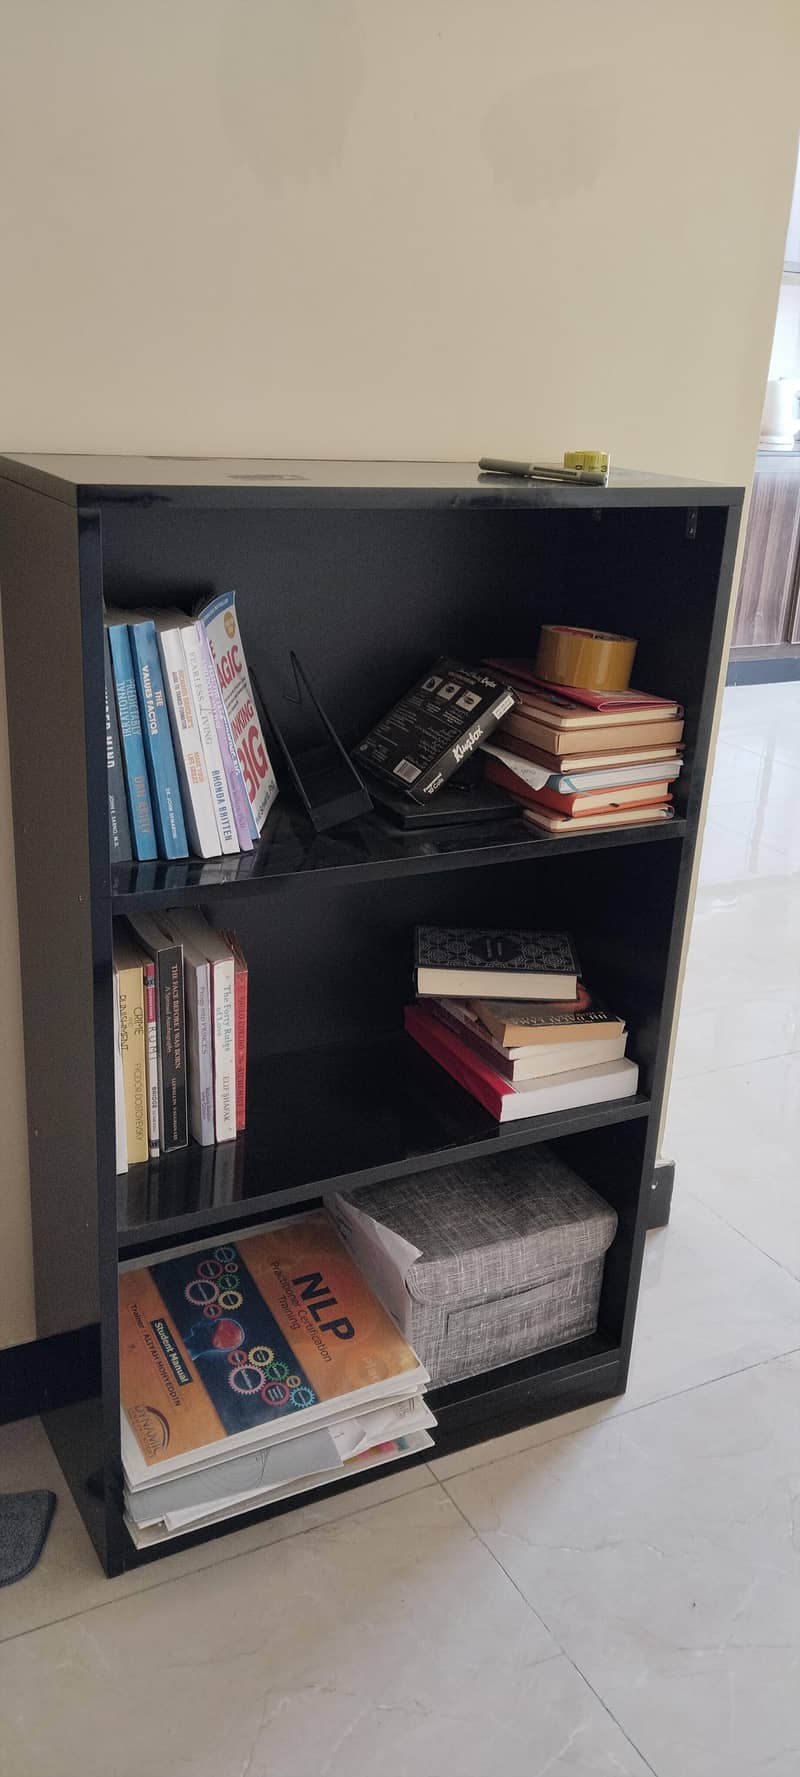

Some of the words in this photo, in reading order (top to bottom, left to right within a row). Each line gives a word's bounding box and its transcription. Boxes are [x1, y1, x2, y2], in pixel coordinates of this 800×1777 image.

[189, 651, 204, 701] FEARLESS
[218, 645, 243, 692] AGIC
[116, 680, 132, 737] IRRATIONAL
[127, 679, 142, 736] PREDICTABLY
[142, 665, 152, 698] VALUES
[147, 701, 159, 736] FACTOR
[154, 690, 164, 708] THE
[134, 776, 146, 798] DAN
[212, 769, 225, 804] RHONDA
[219, 806, 233, 841] BRITTEN
[223, 984, 231, 1003] The
[119, 994, 129, 1051] PUNISHMENT
[132, 1006, 144, 1035] CRIME
[172, 1000, 181, 1027] BEFORE
[222, 1005, 231, 1026] Forty
[148, 1026, 158, 1062] RUMI
[223, 1028, 232, 1052] Rules
[174, 1048, 182, 1072] BORN
[133, 1062, 143, 1094] FYODOR
[223, 1072, 231, 1091] ELIF
[130, 1303, 145, 1329] Trainer
[271, 1258, 301, 1309] Practitioner
[298, 1308, 333, 1363] Certification
[278, 1295, 301, 1330] Training
[291, 1271, 356, 1341] NLP
[154, 1321, 175, 1354] Student
[168, 1352, 190, 1384] Manual
[134, 1404, 161, 1457] DYNAMIC
